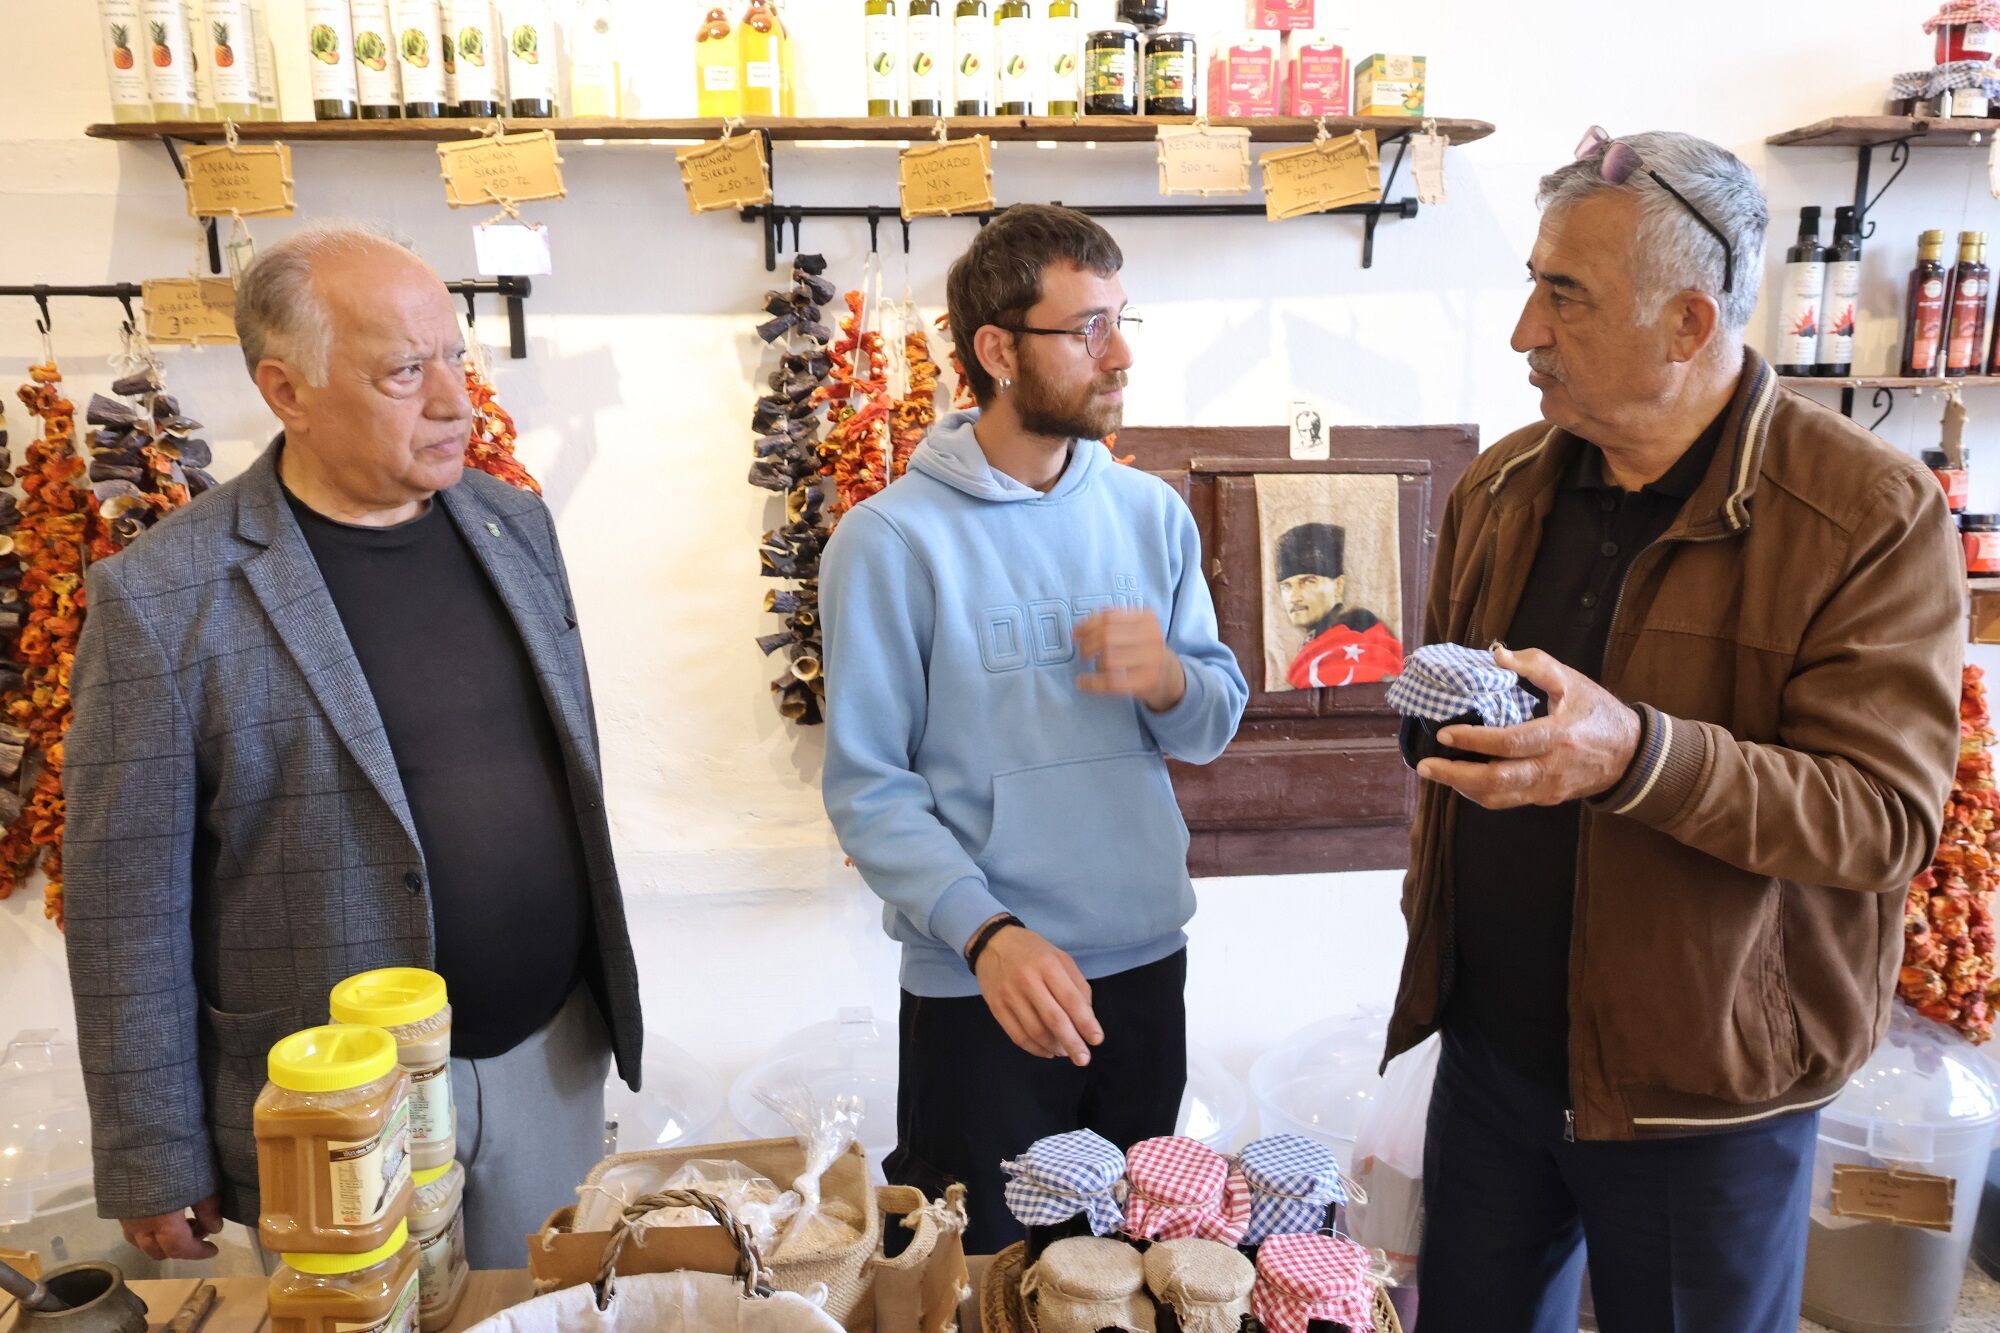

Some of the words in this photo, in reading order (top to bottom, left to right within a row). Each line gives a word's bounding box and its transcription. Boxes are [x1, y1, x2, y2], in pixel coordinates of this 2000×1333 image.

[199, 161, 250, 174] ANANAS
[911, 157, 971, 178] AVOKADO
[1205, 163, 1221, 173] TL
[1276, 158, 1319, 175] DETOX
[515, 176, 531, 185] TL
[718, 179, 742, 193] 250
[743, 176, 756, 185] TL
[244, 190, 262, 200] TL
[956, 191, 973, 201] TL
